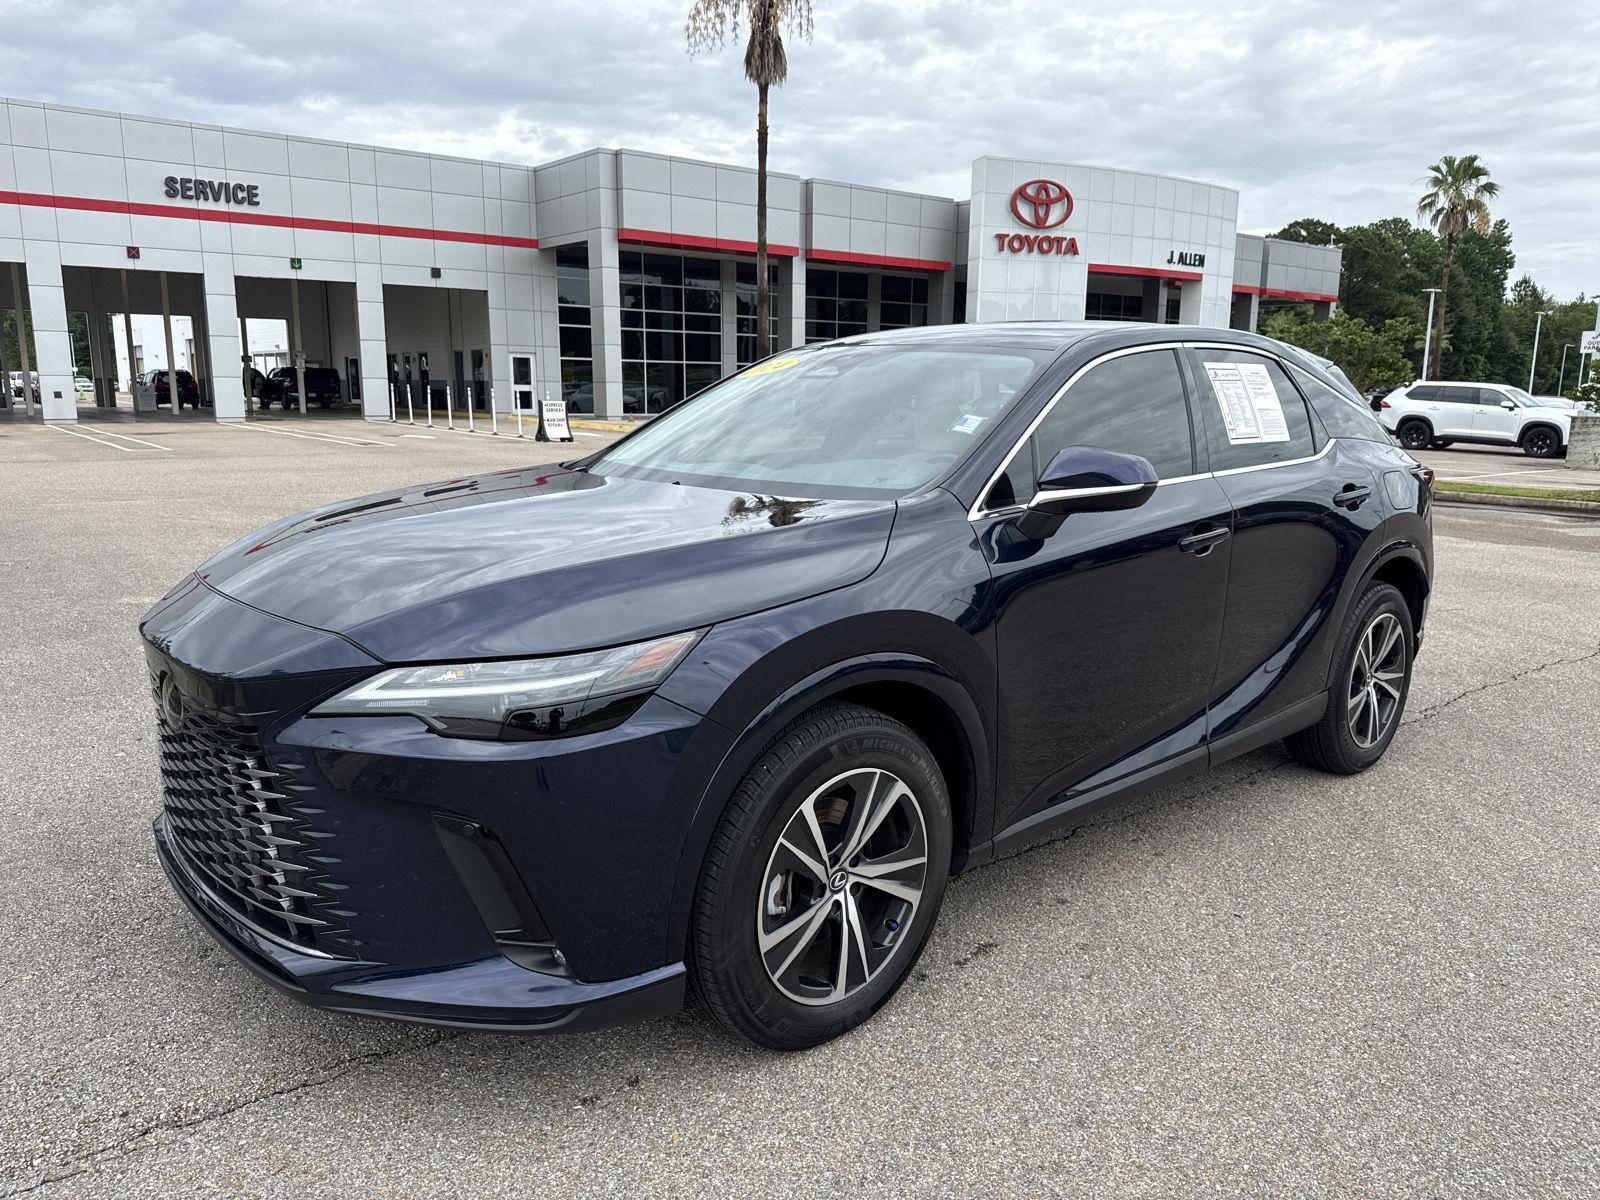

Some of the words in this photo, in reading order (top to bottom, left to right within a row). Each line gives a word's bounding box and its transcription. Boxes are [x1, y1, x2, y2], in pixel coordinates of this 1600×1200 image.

[164, 176, 260, 206] SERVICE
[995, 233, 1079, 256] TOYOTA
[1167, 250, 1176, 264] J.
[1177, 251, 1206, 268] ALLEN
[862, 737, 918, 763] MICHELIN
